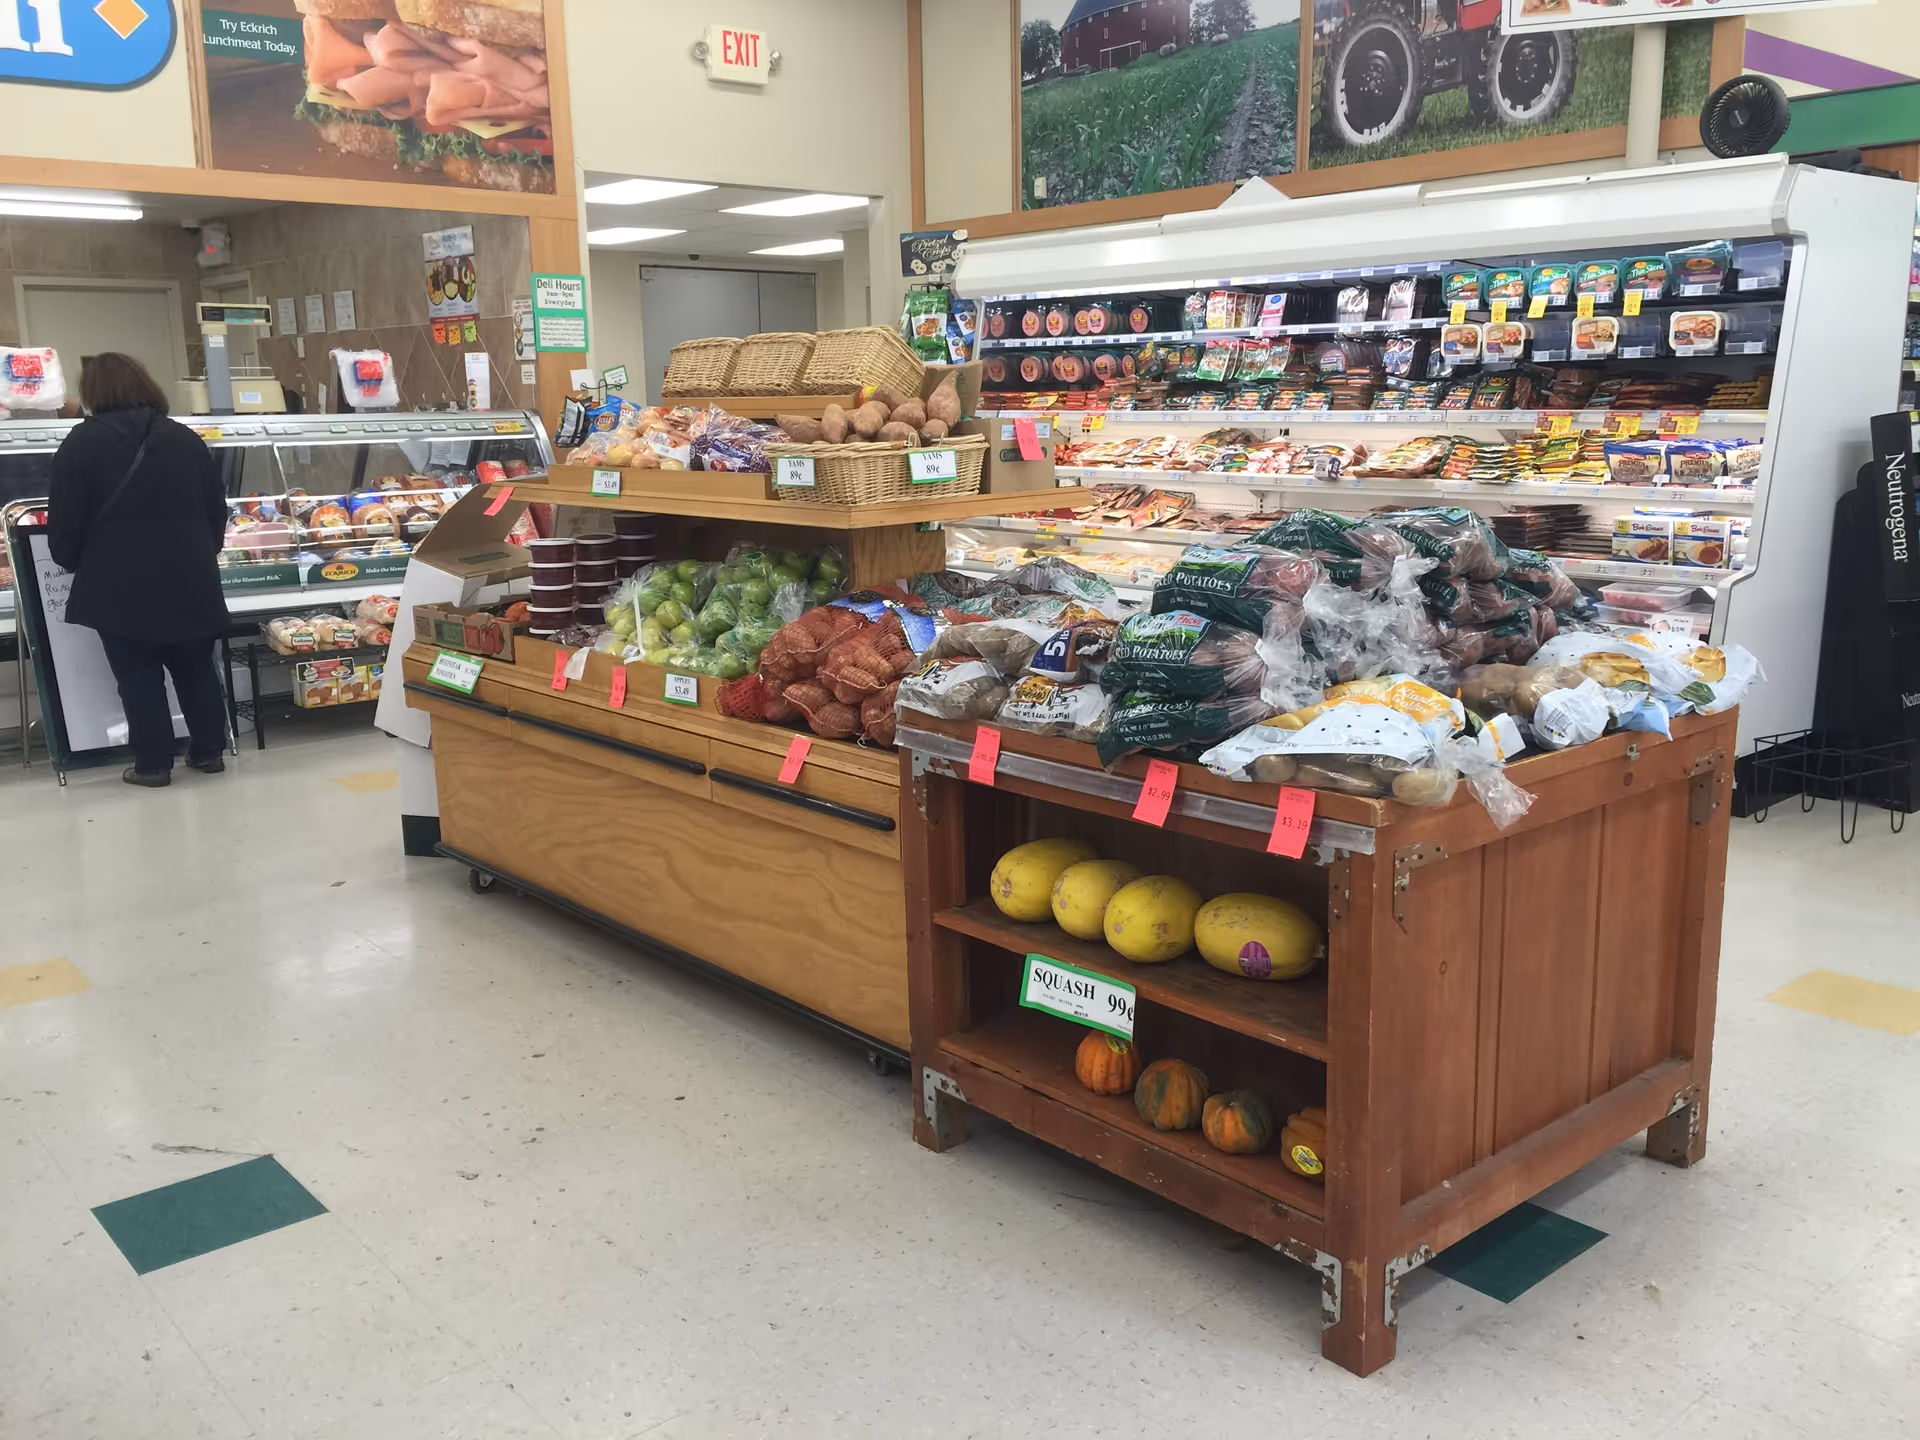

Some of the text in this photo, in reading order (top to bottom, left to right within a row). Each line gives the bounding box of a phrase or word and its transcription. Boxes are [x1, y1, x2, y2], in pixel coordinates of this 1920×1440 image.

[219, 19, 278, 35] Try Eckrich
[203, 33, 298, 56] Lunchmeat Today.
[722, 30, 760, 68] EXIT
[537, 279, 581, 291] Deli Hours
[545, 299, 576, 307] Everyday
[922, 452, 943, 461] YAMS
[926, 464, 940, 474] 89¢
[1618, 459, 1649, 473] PREMIUM
[1680, 459, 1713, 470] PREMIUM
[790, 471, 802, 480] 89¢
[1885, 451, 1908, 562] Neutrogena
[1632, 523, 1664, 532] Bob Evans
[1690, 525, 1720, 534] Bob Evans
[1175, 571, 1234, 592] POTATOES
[1044, 629, 1070, 657] lb 5
[1115, 645, 1187, 660] RED POTATOES
[674, 686, 690, 696] $3.49
[1148, 786, 1171, 801] $2.99
[1282, 816, 1308, 831] $3.19
[1033, 967, 1134, 1025] SQUASH 99¢
